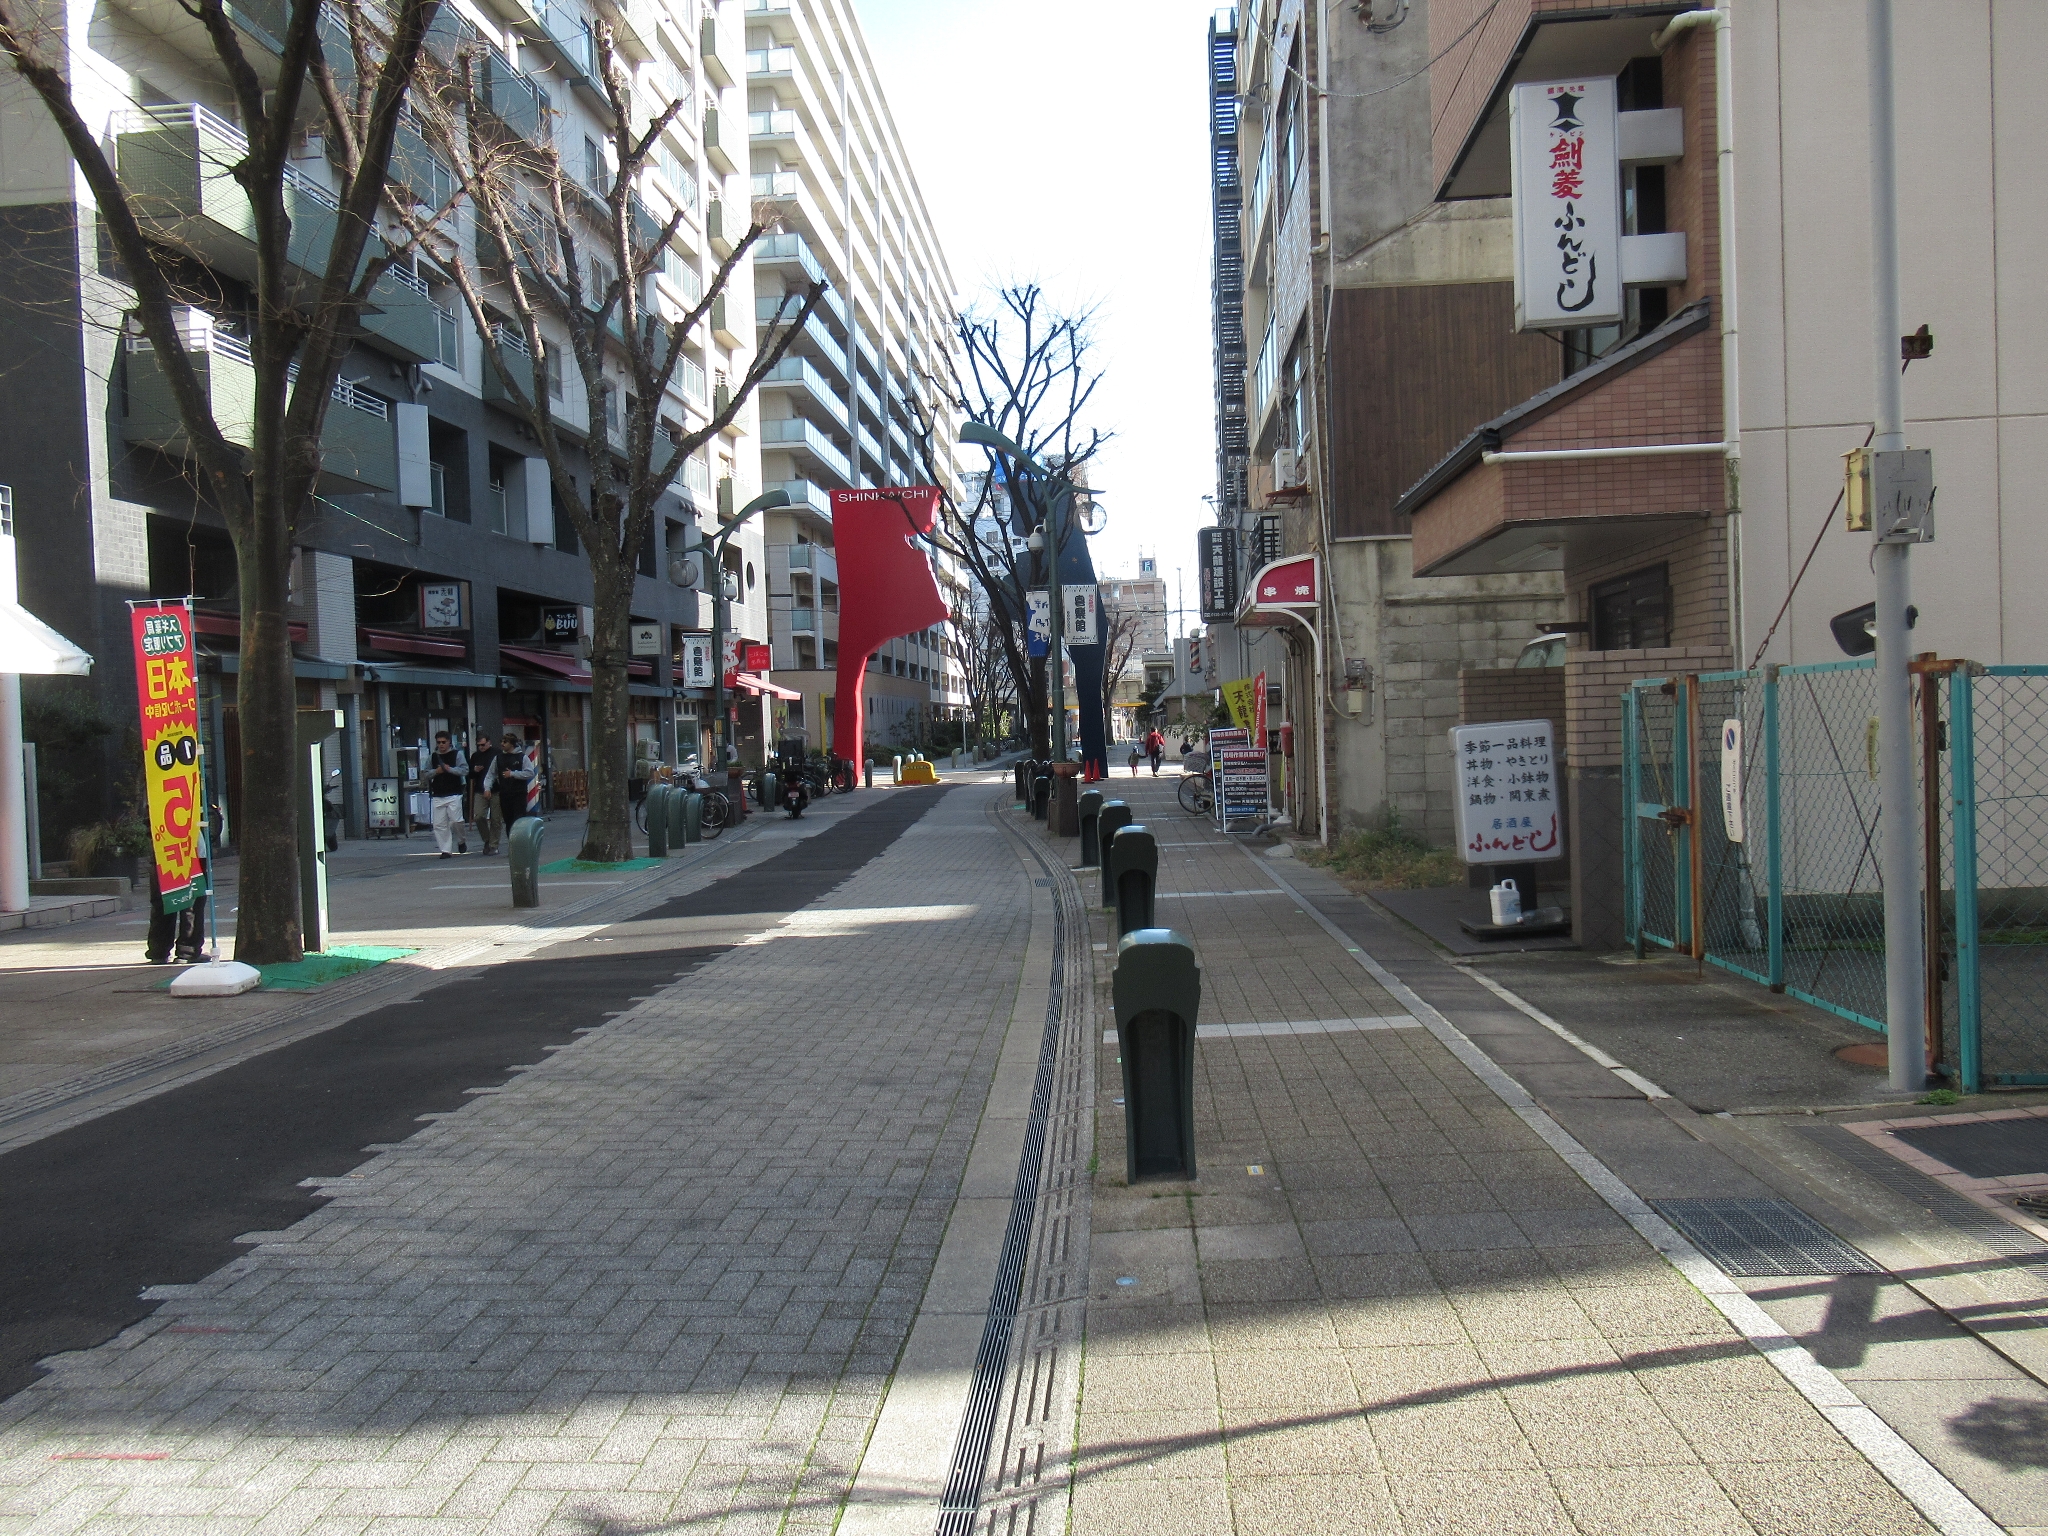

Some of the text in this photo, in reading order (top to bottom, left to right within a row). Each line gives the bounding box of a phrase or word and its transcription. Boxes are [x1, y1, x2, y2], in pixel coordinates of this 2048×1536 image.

[1554, 201, 1597, 312] ふんどし
[556, 619, 578, 630] BUU
[1464, 736, 1548, 755] 季節一品料理
[1467, 771, 1550, 788] 洋食・小鉢物
[1468, 787, 1551, 807] 鍋物・関東煮
[1468, 810, 1558, 853] ふんどし
[1491, 816, 1533, 830] 居酒屋
